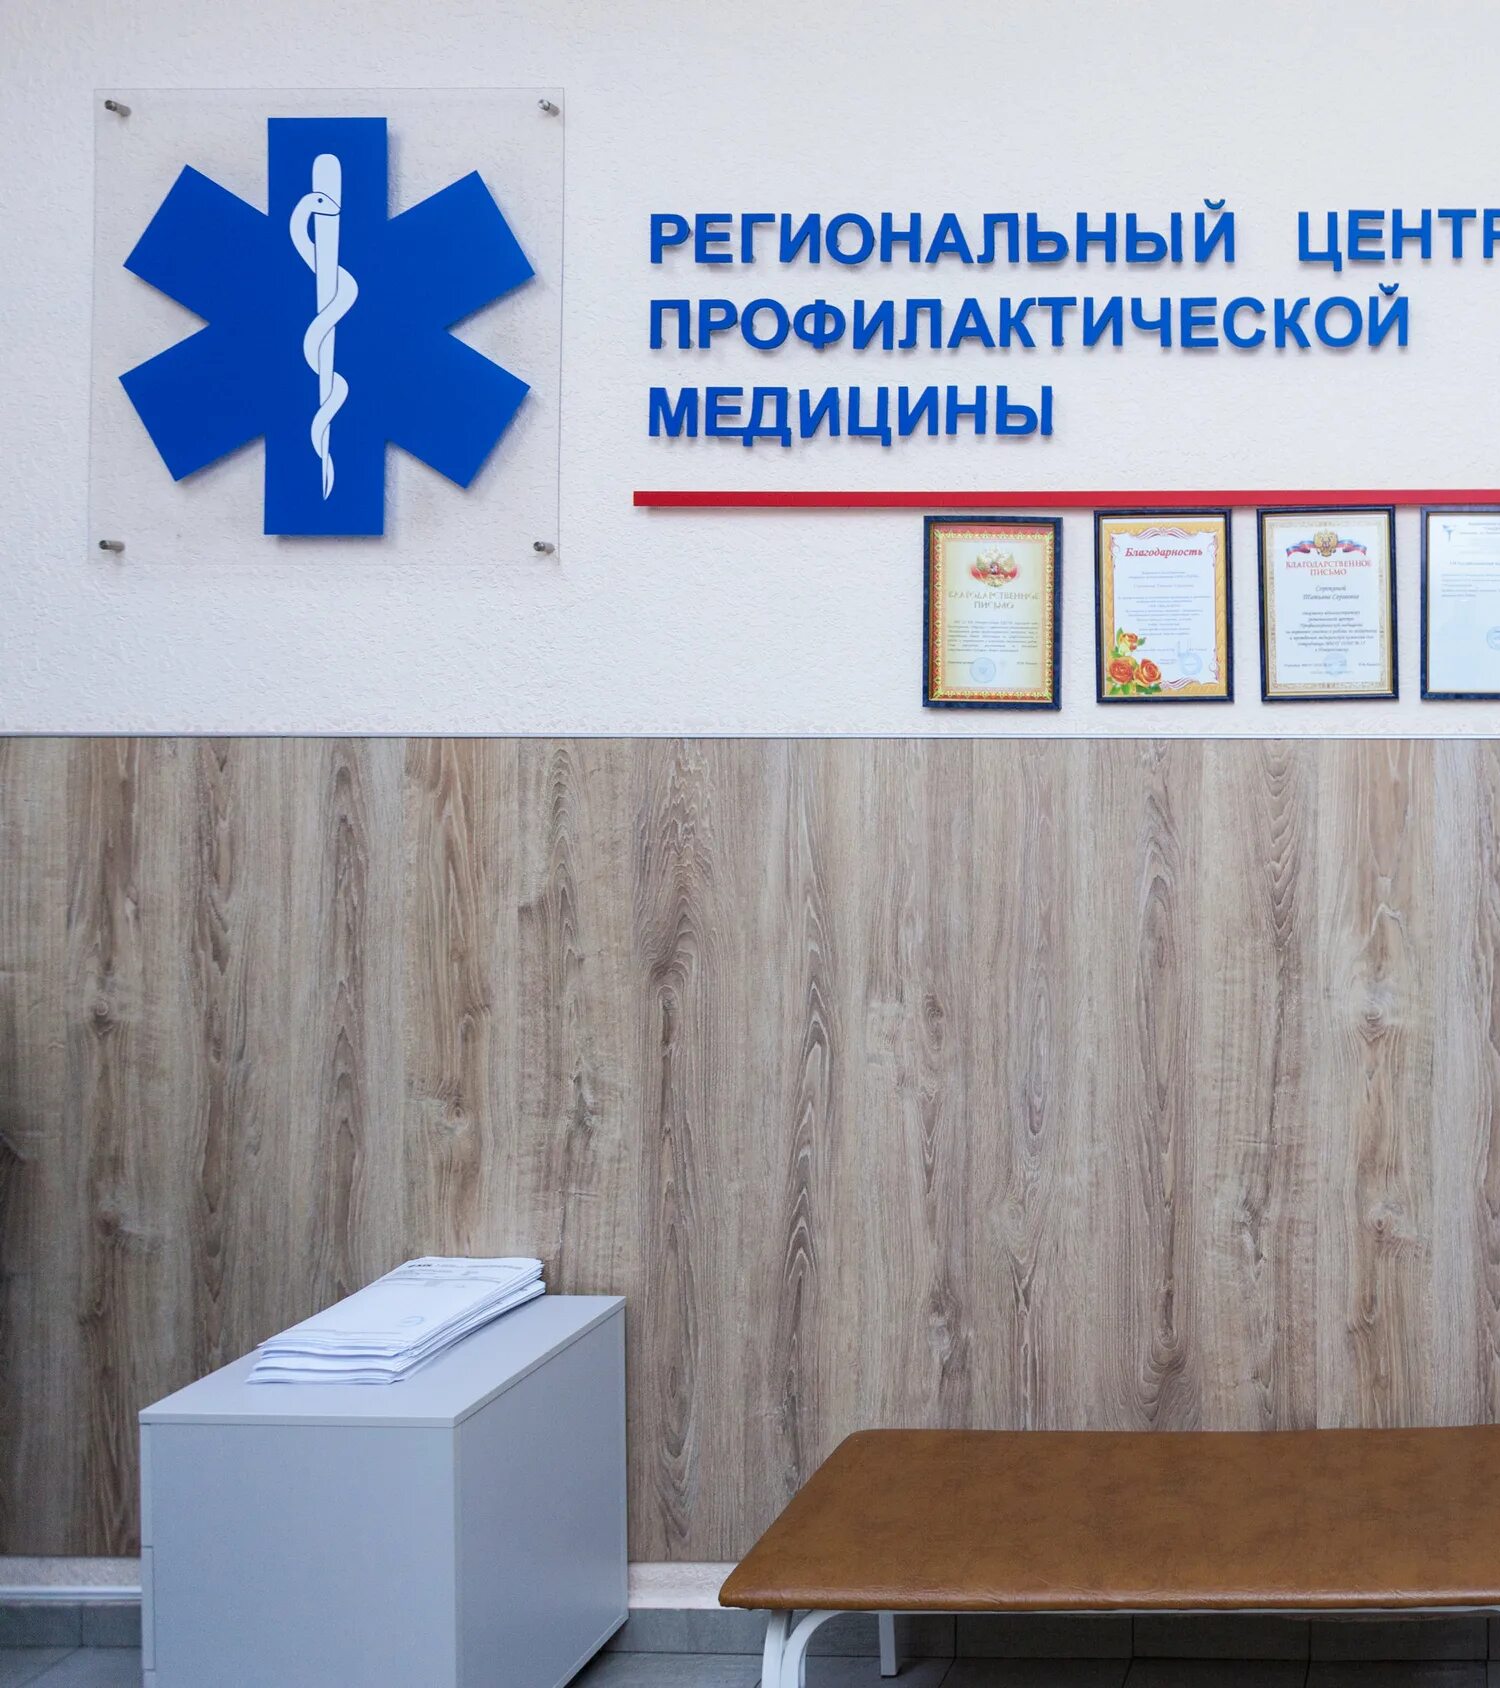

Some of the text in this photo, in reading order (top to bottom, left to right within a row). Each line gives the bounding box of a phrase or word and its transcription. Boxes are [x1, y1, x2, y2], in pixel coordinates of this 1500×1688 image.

[648, 199, 1236, 264] РЕГИОНАЛЬНЫЙ
[648, 283, 1410, 349] ПРОФИЛАКТИЧЕСКОЙ
[648, 385, 1054, 447] МЕДИЦИНЫ
[1125, 547, 1203, 559] Благодарность
[1285, 560, 1372, 569] БЛАГОДАРСТВЕННОЕ
[1310, 568, 1347, 576] ПИСЬМО
